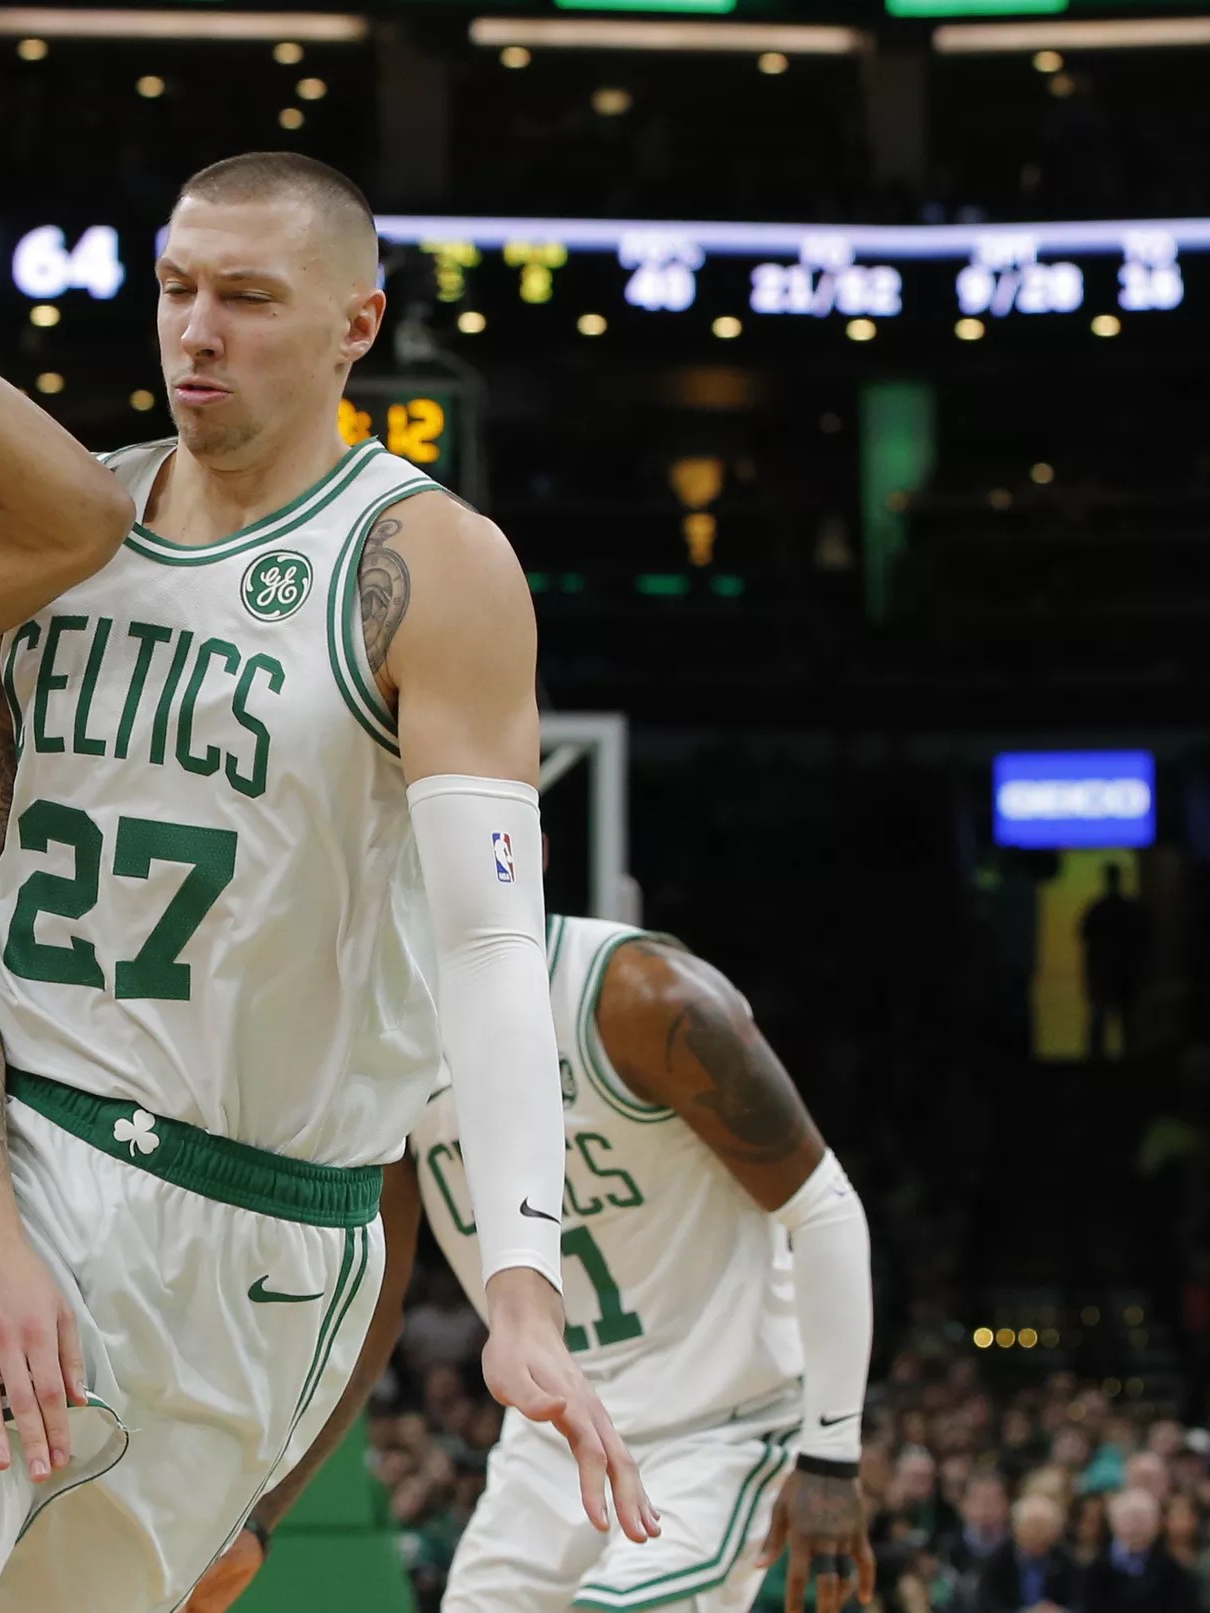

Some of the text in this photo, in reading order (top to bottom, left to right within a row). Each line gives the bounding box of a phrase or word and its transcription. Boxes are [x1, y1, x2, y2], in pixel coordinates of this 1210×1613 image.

[12, 224, 125, 300] 64
[3, 615, 286, 799] CELTICS
[3, 799, 239, 1001] 27
[560, 1225, 643, 1353] 1
